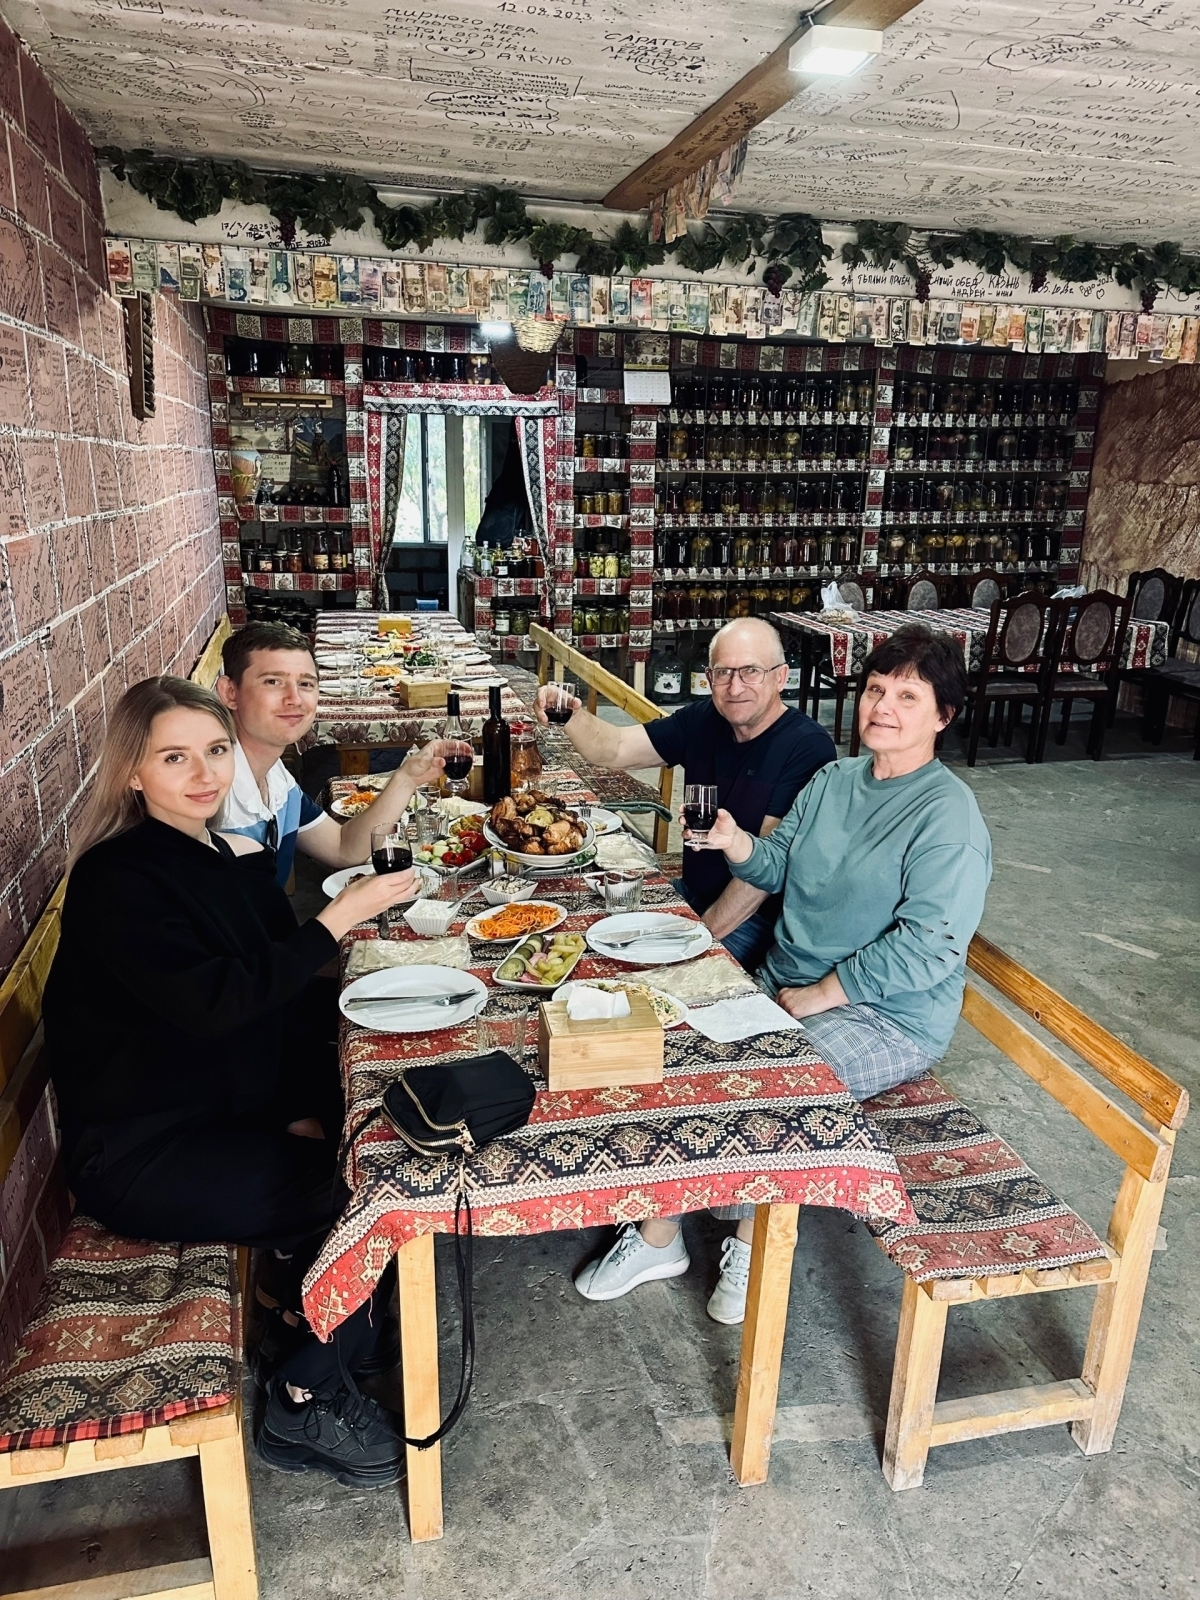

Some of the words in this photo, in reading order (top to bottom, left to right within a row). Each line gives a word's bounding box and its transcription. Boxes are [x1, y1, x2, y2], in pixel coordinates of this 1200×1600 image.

[604, 33, 703, 50] САРАТОВ
[950, 286, 985, 298] АНДРЕЙ
[517, 304, 526, 315] 20
